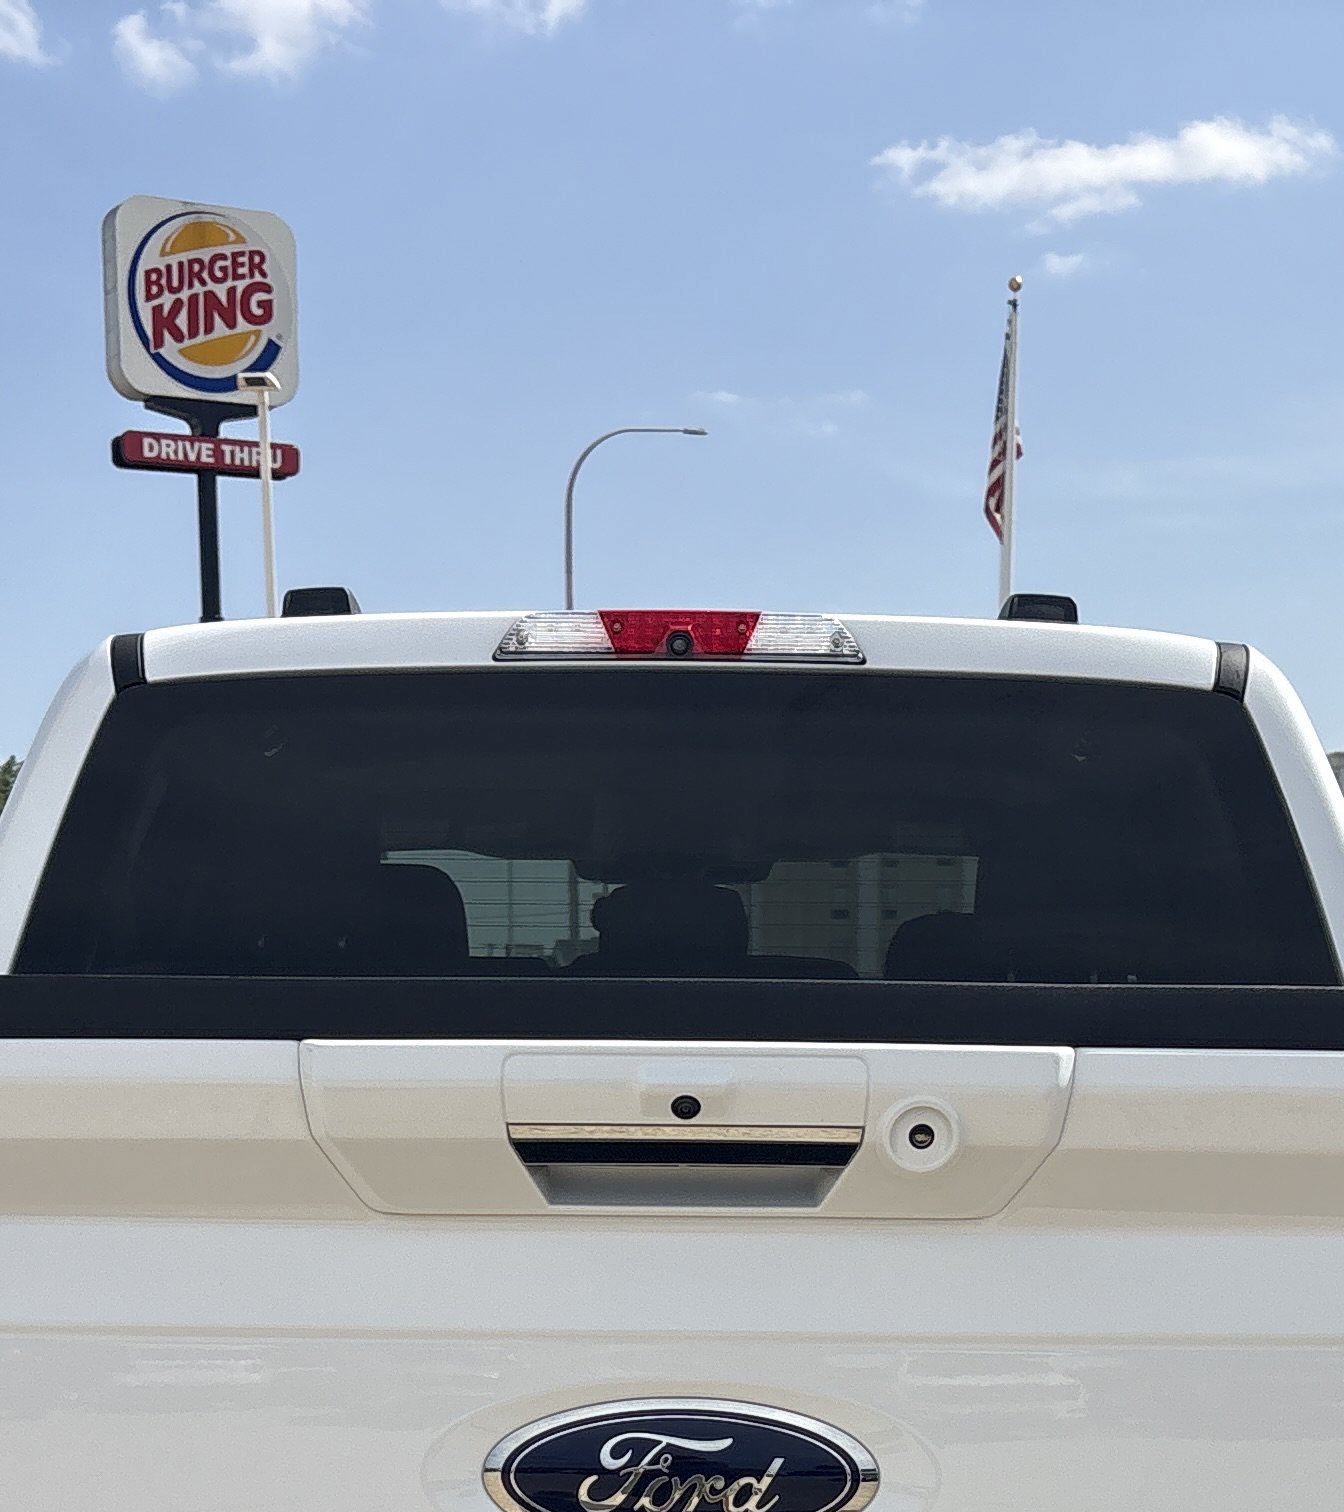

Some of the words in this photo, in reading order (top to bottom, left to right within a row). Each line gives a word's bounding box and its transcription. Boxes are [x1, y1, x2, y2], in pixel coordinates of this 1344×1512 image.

[144, 249, 268, 303] BURGER
[150, 281, 274, 351] KING
[142, 437, 216, 464] DRIVE
[221, 444, 284, 469] THRU
